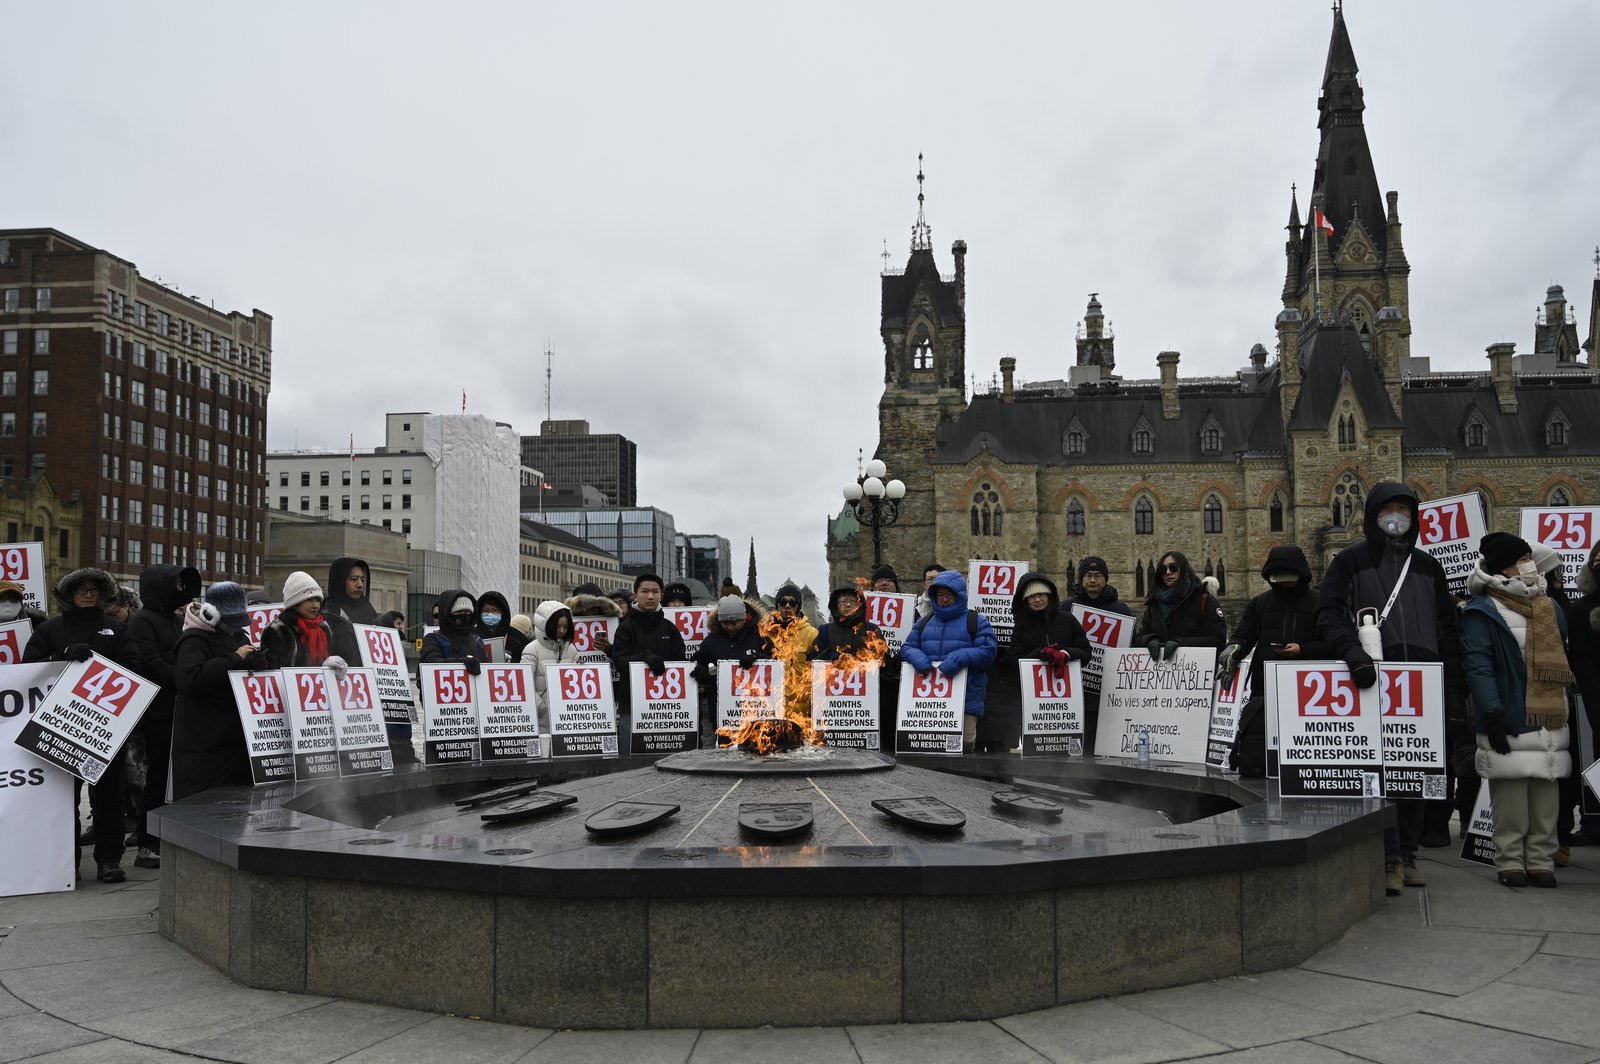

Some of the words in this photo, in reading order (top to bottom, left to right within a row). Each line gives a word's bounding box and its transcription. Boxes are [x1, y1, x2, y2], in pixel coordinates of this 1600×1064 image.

[1423, 504, 1458, 542] 37
[1543, 513, 1586, 548] 25
[1428, 542, 1467, 556] MONTHS
[1462, 551, 1480, 561] FOR
[982, 566, 1011, 594] 42
[982, 598, 1010, 606] MONTHS
[869, 598, 898, 626] 16
[680, 612, 710, 640] 34
[1086, 614, 1117, 645] 27
[370, 632, 393, 664] 39
[1117, 654, 1152, 671] ASSEZ
[1172, 654, 1197, 671] délais
[377, 668, 398, 677] MONTHS
[564, 669, 597, 699] 36
[649, 668, 681, 699] 38
[829, 669, 862, 695] 34
[917, 668, 948, 697] 35
[1038, 666, 1066, 697] 16
[1115, 670, 1213, 690] INTERMINABLE
[82, 668, 131, 713] 42
[439, 670, 467, 703] 55
[493, 670, 522, 701] 51
[248, 677, 279, 713] 34
[301, 674, 329, 710] 23
[340, 674, 368, 709] 23
[384, 688, 410, 697] RESPONSE
[1303, 671, 1354, 716] 25
[828, 700, 862, 708] MONTHS
[1107, 693, 1122, 707] Nos
[1125, 696, 1139, 707] vies
[1142, 695, 1158, 708] sont
[1161, 699, 1172, 708] en
[1175, 697, 1210, 712] suspens.
[69, 699, 110, 725] MONTHS
[440, 707, 467, 716] MONTHS
[493, 706, 522, 714] MONTHS
[347, 714, 372, 723] MONTHS
[487, 716, 516, 724] WAITING
[517, 715, 530, 723] FOR
[641, 712, 672, 720] WAITING
[1062, 712, 1076, 720] FOR
[53, 704, 93, 730] WAITING
[93, 725, 112, 741] FOR
[257, 719, 284, 728] MONTHS
[433, 718, 461, 726] WAITING
[462, 717, 475, 725] FOR
[573, 722, 611, 730] RESPONSE
[636, 722, 653, 730] IRCC
[654, 721, 693, 729] RESPONSE
[919, 720, 958, 728] RESPONSE
[1028, 723, 1043, 731] IRCC
[1044, 722, 1080, 730] RESPONSE
[342, 726, 367, 734] WAITING
[369, 724, 380, 733] FOR
[429, 728, 444, 737] IRCC
[445, 726, 478, 736] RESPONSE
[484, 725, 499, 734] IRCC
[500, 725, 534, 733] RESPONSE
[1125, 719, 1180, 735] Transparence.
[1305, 722, 1354, 732] MONTHS
[1383, 724, 1416, 734] NTHS
[40, 711, 62, 728] IRCC
[61, 723, 112, 754] RESPONSE
[253, 730, 279, 740] WAITING
[300, 728, 328, 737] WAITING
[298, 740, 312, 749] IRCC
[341, 737, 354, 746] IRCC
[355, 734, 385, 744] RESPONSE
[1293, 736, 1342, 746] WAITING
[1345, 736, 1368, 746] FOR
[1407, 737, 1430, 748] FOR
[39, 731, 52, 742] NO
[53, 736, 88, 760] TIMELINE
[252, 742, 266, 752] IRCC
[445, 742, 472, 750] TIMELINES
[504, 746, 527, 754] RESULTS
[36, 741, 50, 752] NO
[49, 746, 82, 769] RESULTS
[349, 752, 356, 760] NO
[438, 751, 446, 759] NO
[1287, 749, 1312, 759] IRCC
[1314, 749, 1376, 759] RESPONSE
[1384, 751, 1437, 762] ESPONSE
[352, 761, 360, 769] NO
[1299, 769, 1312, 777] NO
[1314, 769, 1364, 778] TIMELINES
[1304, 781, 1317, 789] NO
[1320, 781, 1360, 789] RESULTS
[1386, 782, 1421, 791] ESULTS
